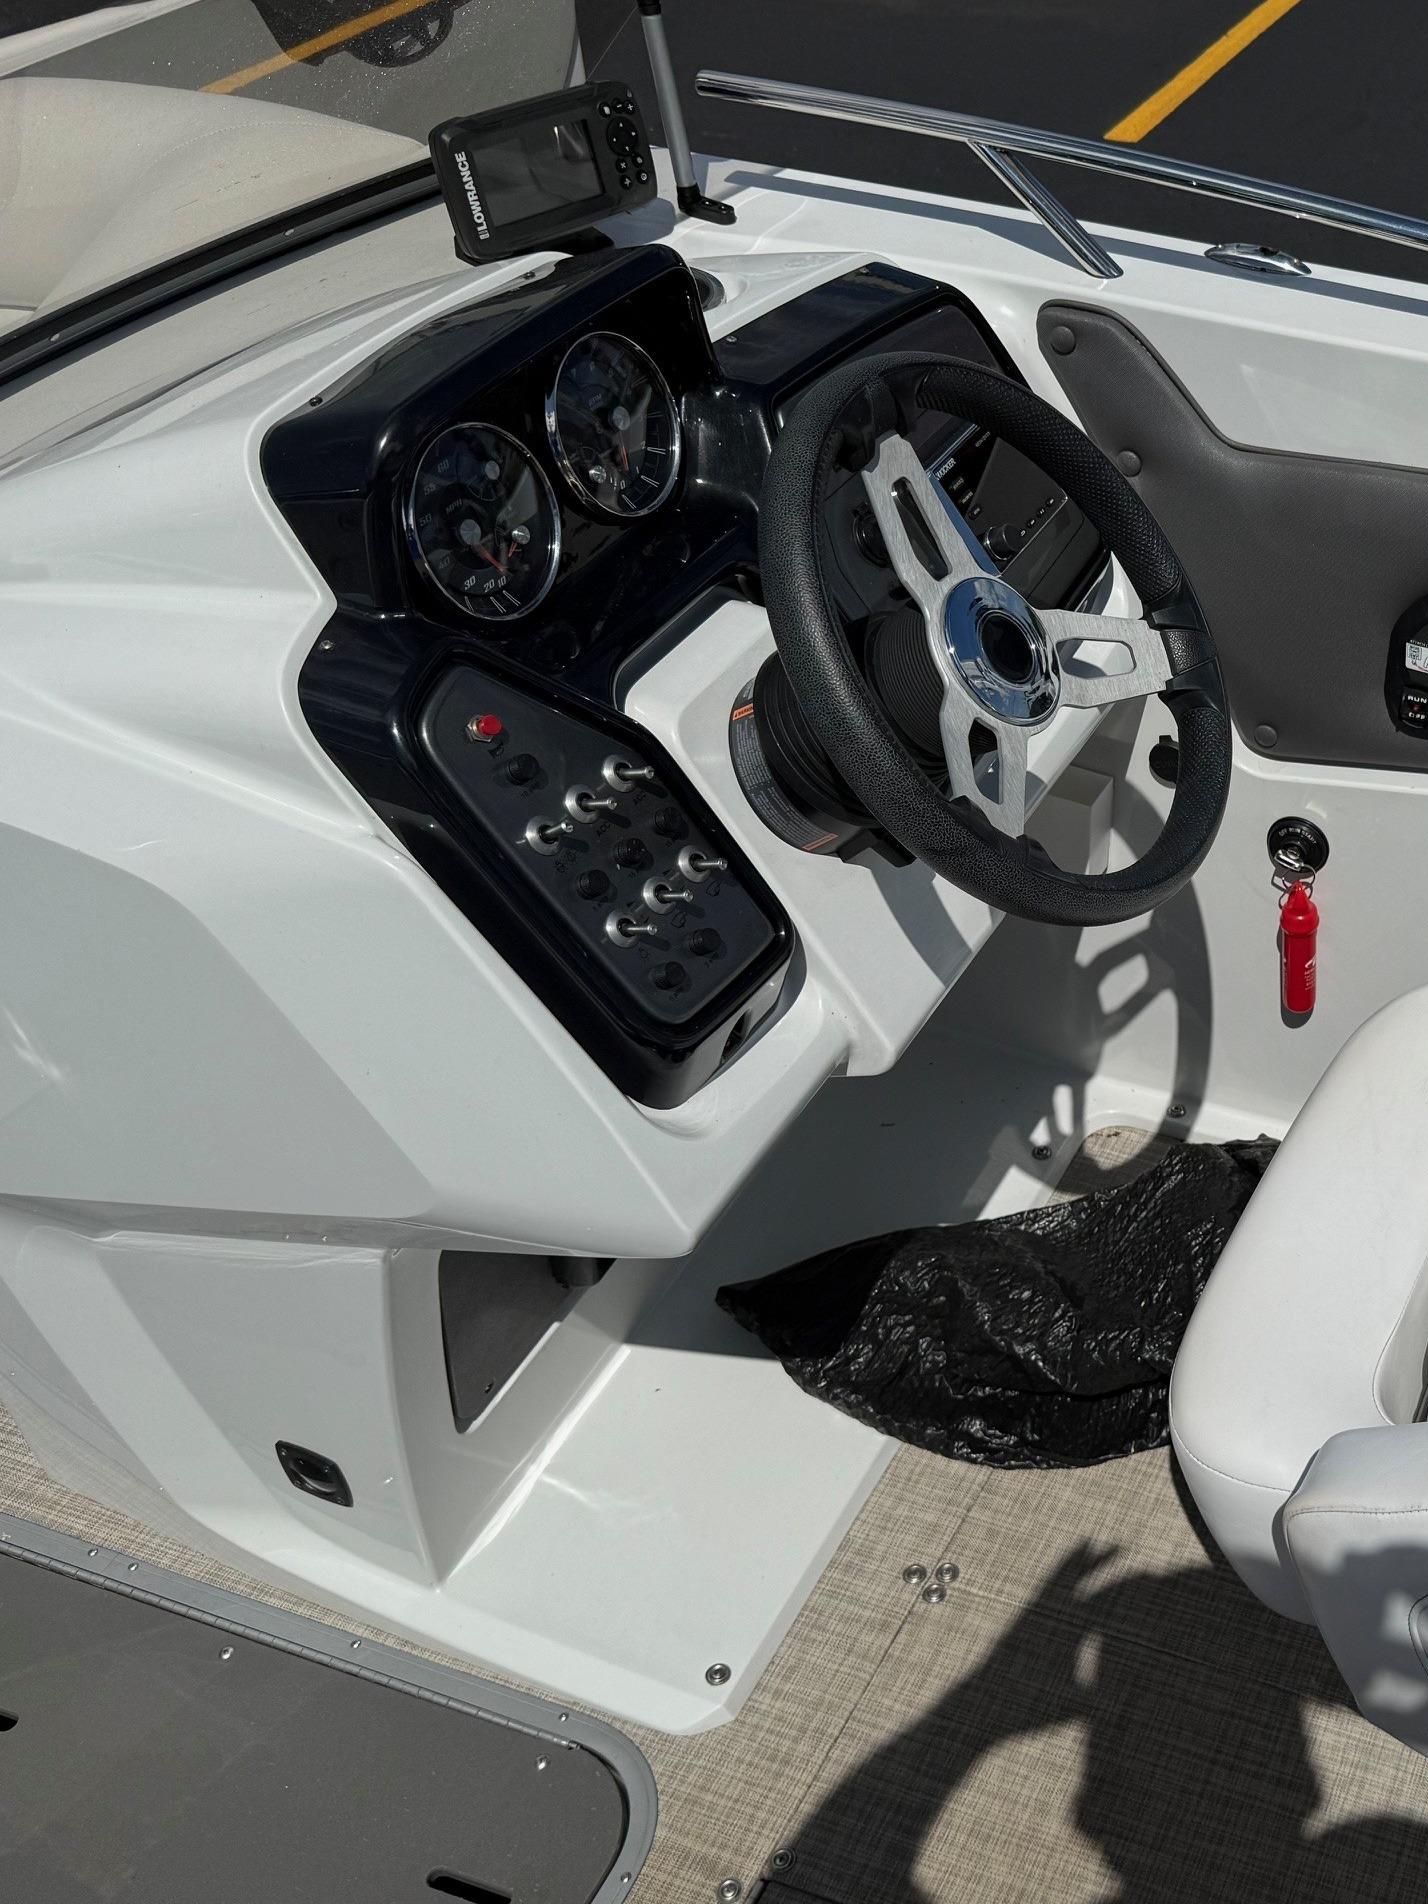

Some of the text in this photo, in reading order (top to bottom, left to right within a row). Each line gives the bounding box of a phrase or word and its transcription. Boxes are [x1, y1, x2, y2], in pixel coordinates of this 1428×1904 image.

[455, 152, 487, 232] LOWRANCE
[445, 499, 463, 514] MPH
[464, 576, 476, 591] 30
[483, 579, 495, 593] 20
[497, 576, 507, 588] 10
[1407, 695, 1428, 704] RUN
